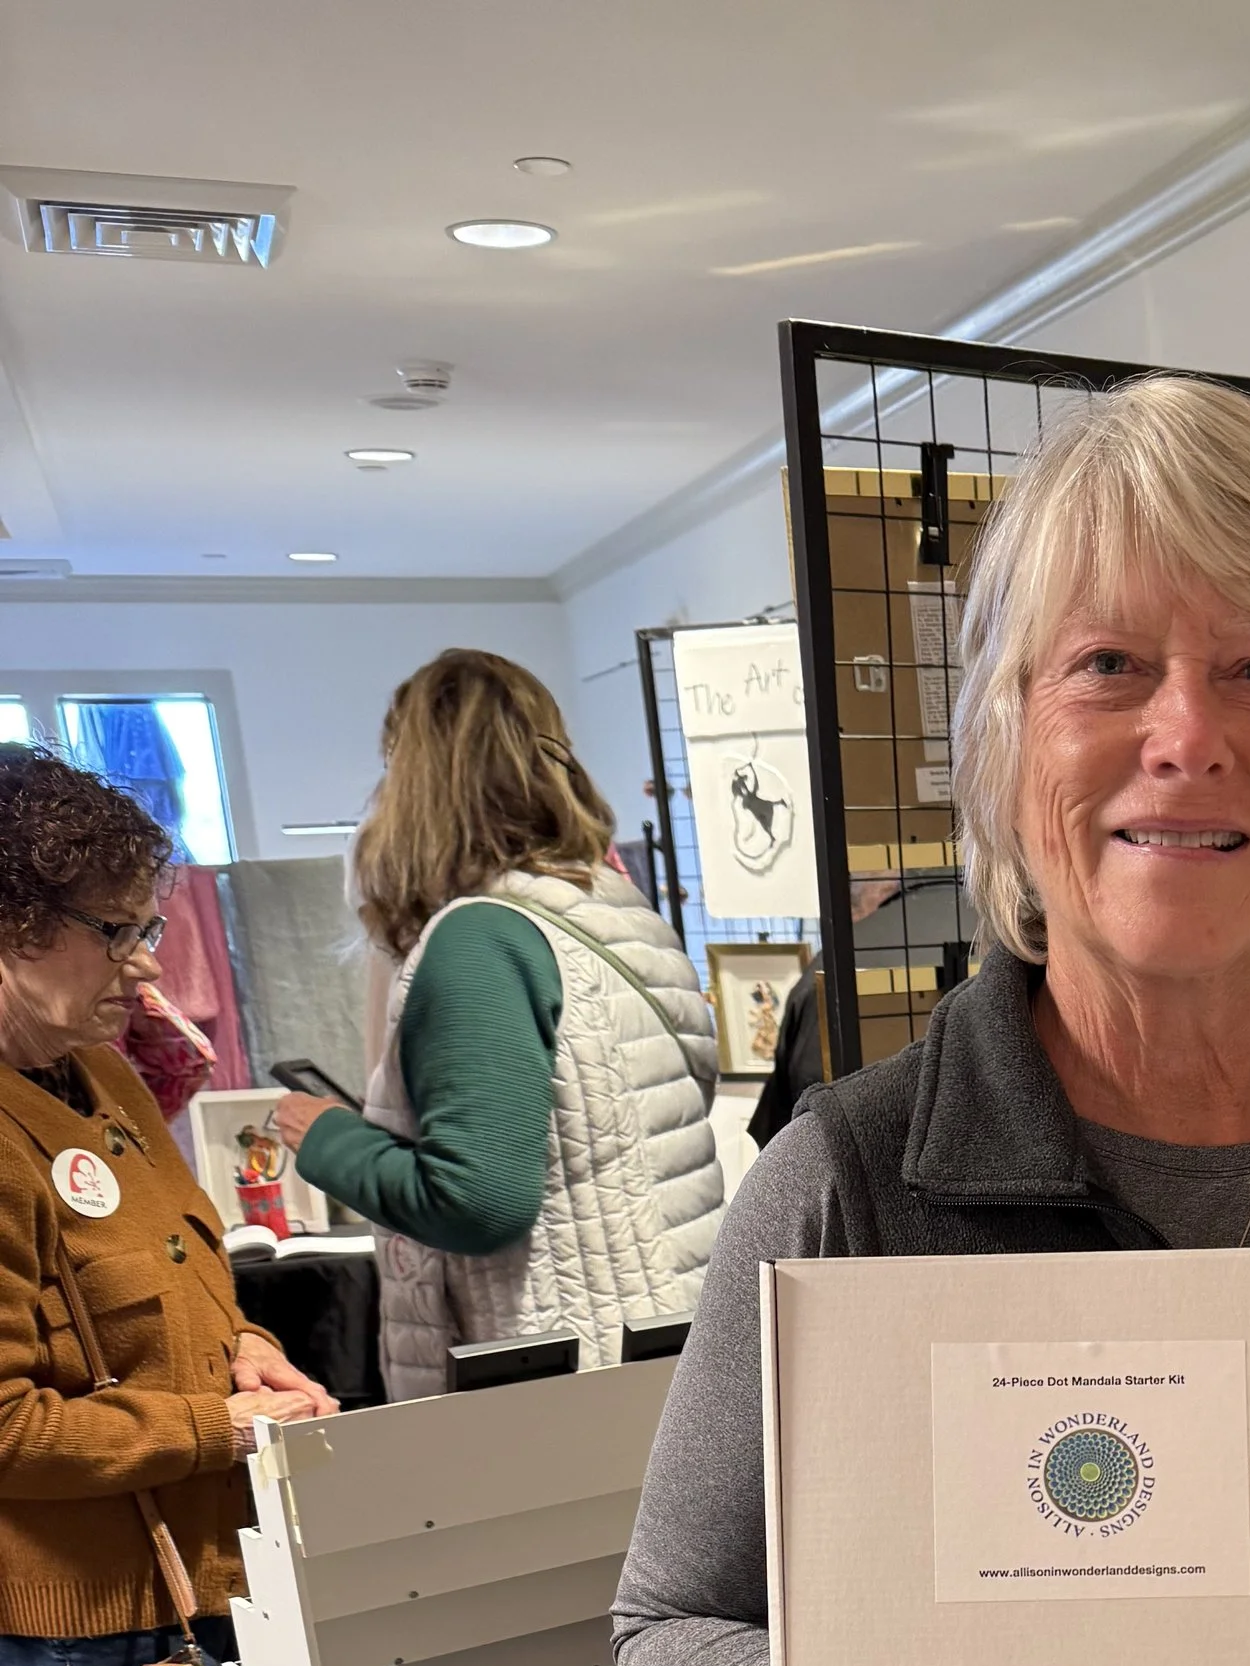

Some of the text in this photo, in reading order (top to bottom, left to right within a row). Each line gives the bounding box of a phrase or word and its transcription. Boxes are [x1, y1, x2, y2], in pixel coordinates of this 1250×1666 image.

[684, 683, 736, 716] The
[744, 658, 791, 697] Art
[71, 1195, 107, 1209] MEMBER
[992, 1374, 1185, 1388] 24-Piece Dot Mandala Starter Kit
[1027, 1412, 1156, 1539] ALLISON IN WONDERLAND DESIGNS
[979, 1563, 1206, 1579] www.allisoninwonderlanddesigns.com
